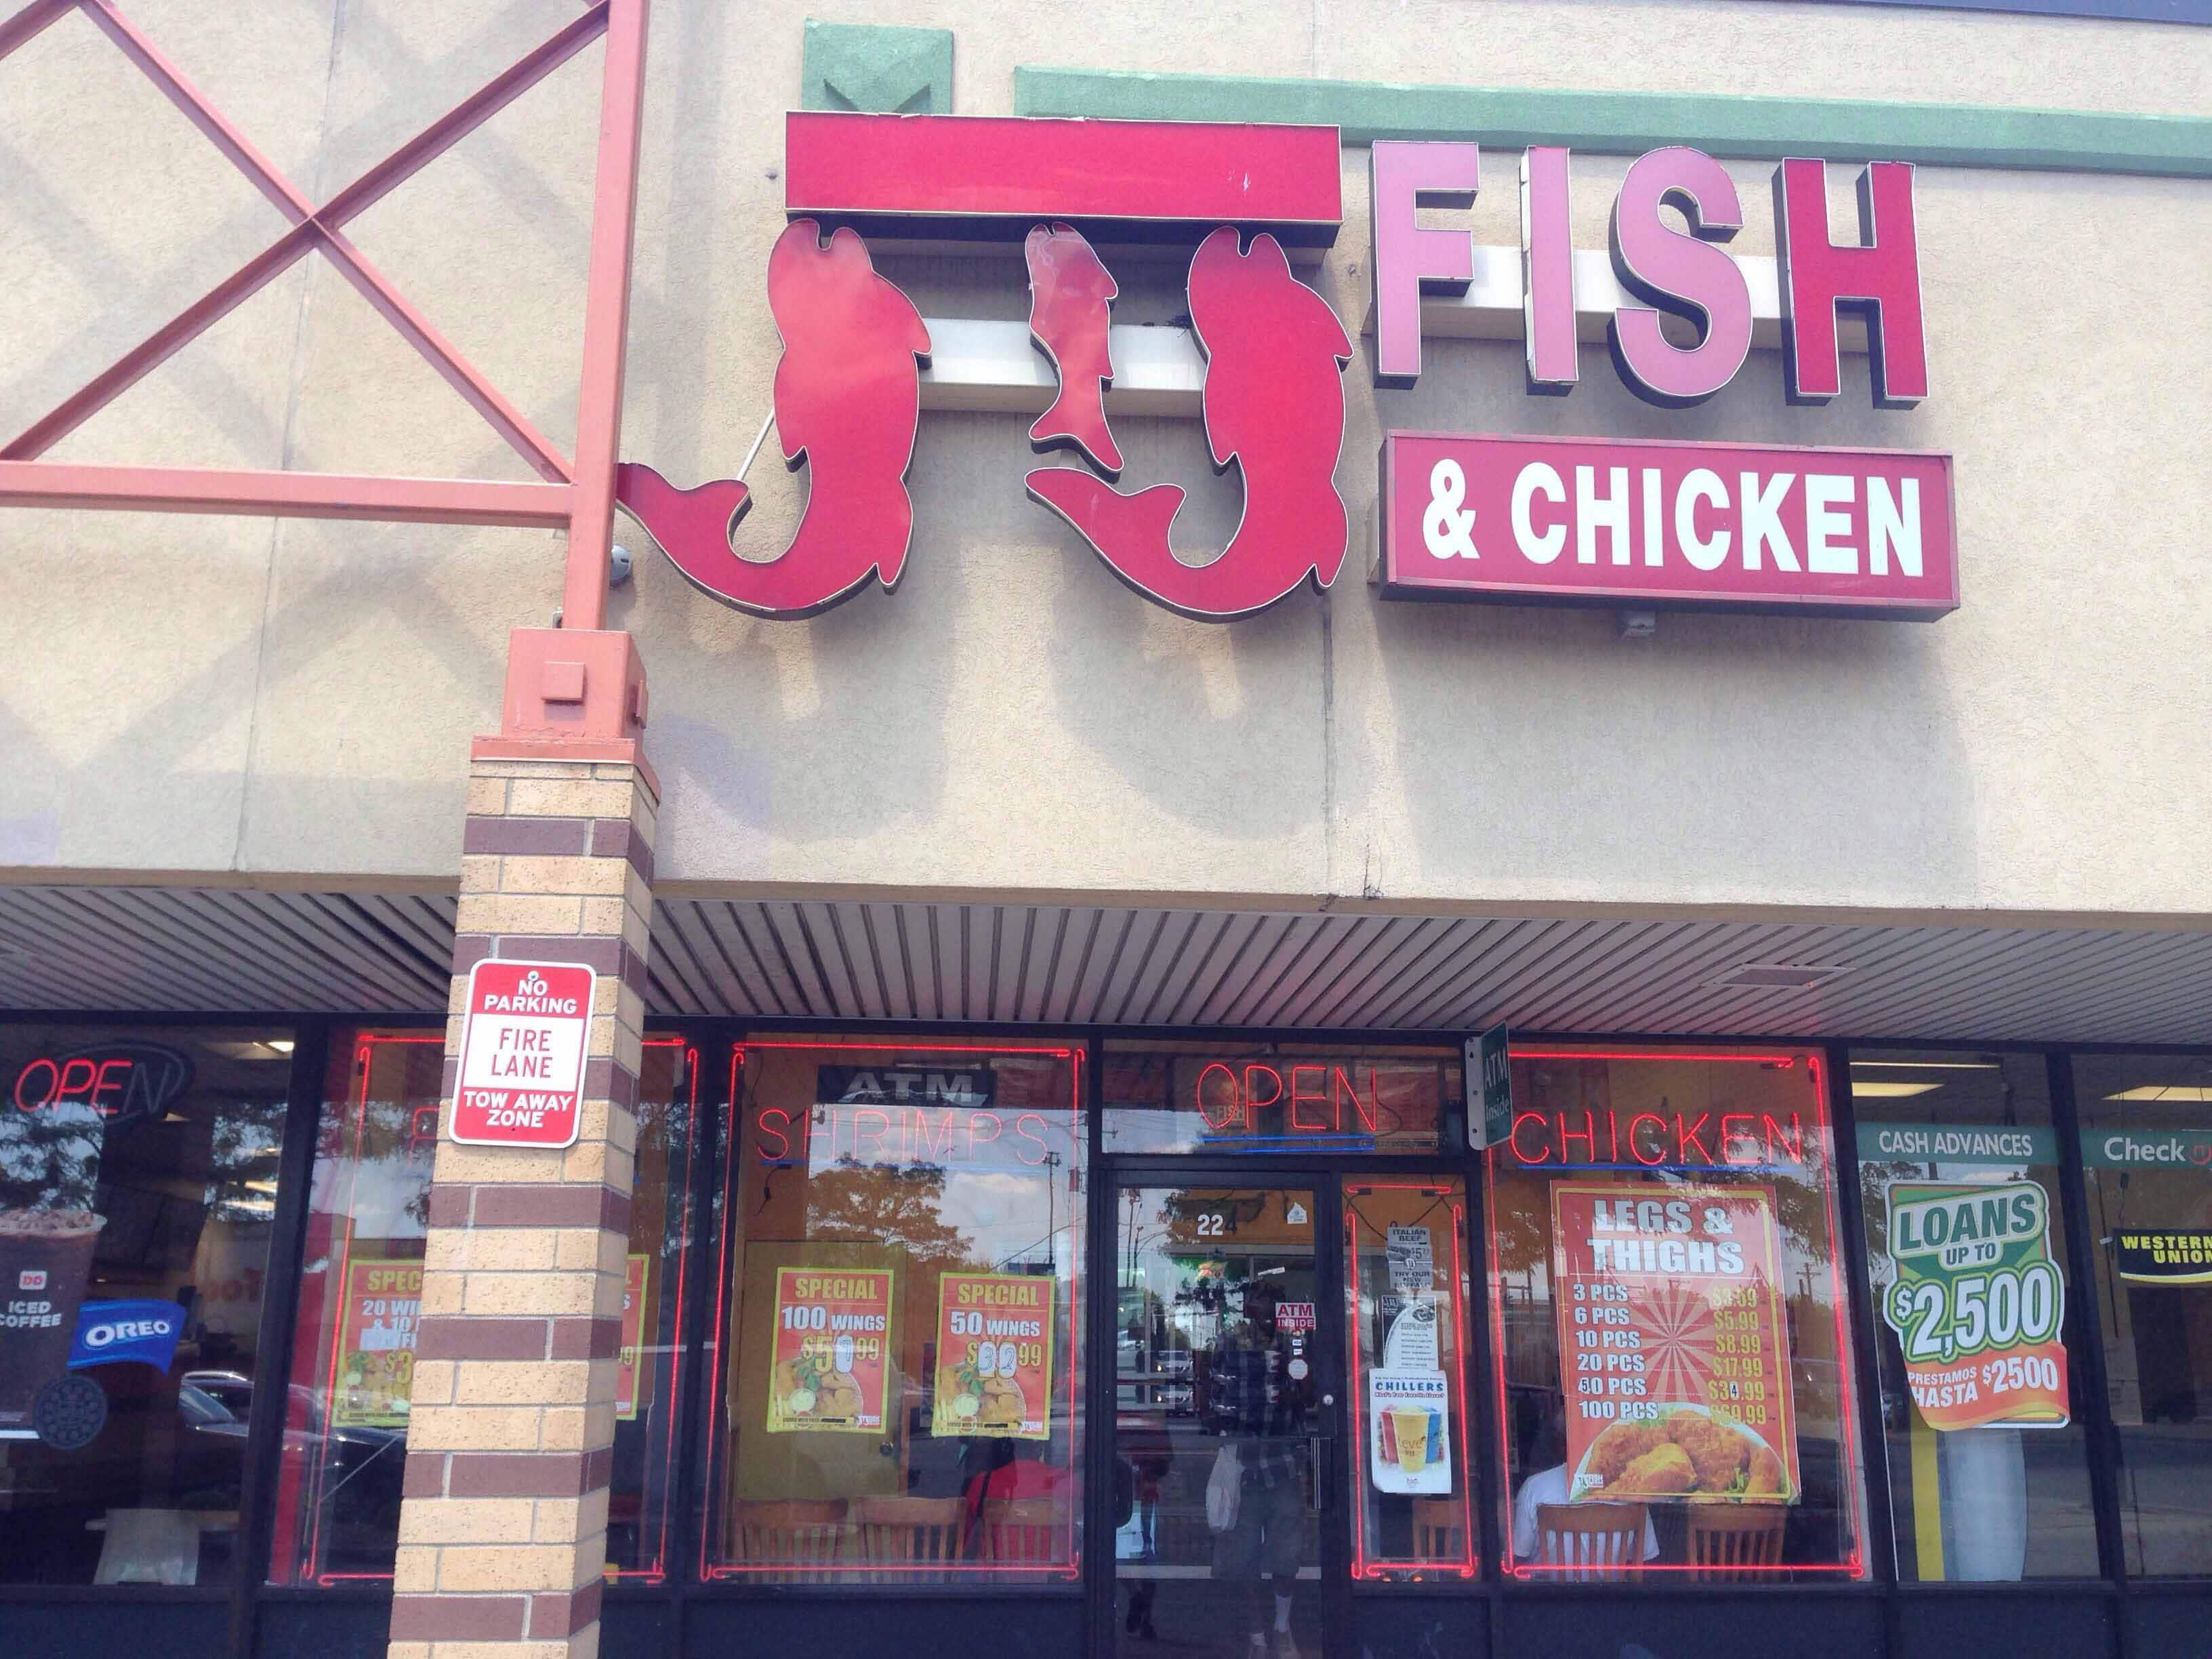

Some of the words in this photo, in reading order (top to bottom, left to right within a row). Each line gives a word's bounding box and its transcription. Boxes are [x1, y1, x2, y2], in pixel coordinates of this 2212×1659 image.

[1372, 140, 1929, 407] FISH
[1422, 458, 1480, 560] &
[1511, 461, 1923, 577] CHICKEN
[518, 980, 548, 996] NO
[484, 994, 577, 1014] PARKING
[499, 1028, 552, 1052] FIRE
[491, 1054, 553, 1078] LANE
[1485, 1046, 1508, 1088] ATM
[14, 1058, 172, 1114] OPEN
[840, 1071, 976, 1103] ATM
[1196, 1062, 1377, 1131] OPEN
[464, 1091, 508, 1107] TOW
[513, 1094, 573, 1111] AWAY
[486, 1109, 545, 1128] ZONE
[756, 1107, 1048, 1165] SHRIMPS
[1510, 1111, 1802, 1165] CHICKEN
[1879, 1130, 1929, 1155] CASH
[1933, 1132, 2032, 1157] ADVANCES
[2104, 1136, 2186, 1162] Check
[1197, 1214, 1223, 1235] 22
[1593, 1200, 1692, 1233] LEGS
[1702, 1206, 1734, 1235] &
[1899, 1193, 2035, 1252] LOANS
[1945, 1246, 1969, 1266] UP
[1973, 1242, 1997, 1262] TO
[2121, 1235, 2212, 1250] WESTERN
[1586, 1238, 1744, 1274] THIGHS
[795, 1277, 878, 1299] SPECIAL
[958, 1283, 1039, 1306] SPECIAL
[1573, 1284, 1585, 1301] 3
[1590, 1284, 1629, 1302] PCS
[9, 1300, 52, 1314] ICED
[363, 1299, 386, 1315] 20
[782, 1306, 826, 1330] 100
[831, 1315, 885, 1331] WINGS
[1277, 1304, 1312, 1316] ATM
[1574, 1307, 1587, 1324] 6
[1592, 1307, 1630, 1325] PCS
[1713, 1311, 1759, 1331] $5.99
[1896, 1267, 2051, 1357] $2,500
[85, 1319, 170, 1347] OREO
[950, 1311, 982, 1335] 50
[986, 1319, 1040, 1336] WINGS
[1277, 1319, 1313, 1327] INSIDE
[1576, 1330, 1597, 1348] 10
[1602, 1330, 1641, 1349] PCS
[1715, 1334, 1761, 1353] $8.99
[1577, 1353, 1602, 1371] 20
[1607, 1353, 1645, 1372] PCS
[1713, 1357, 1763, 1378] $17.99
[1906, 1366, 1978, 1386] PRESTAMOS
[1982, 1355, 2058, 1393] $2500
[1375, 1382, 1443, 1391] CHILLERS
[1608, 1377, 1647, 1396] PCS
[1910, 1381, 1979, 1408] HASTA
[1579, 1400, 1615, 1418] 100
[1620, 1401, 1659, 1420] PCS
